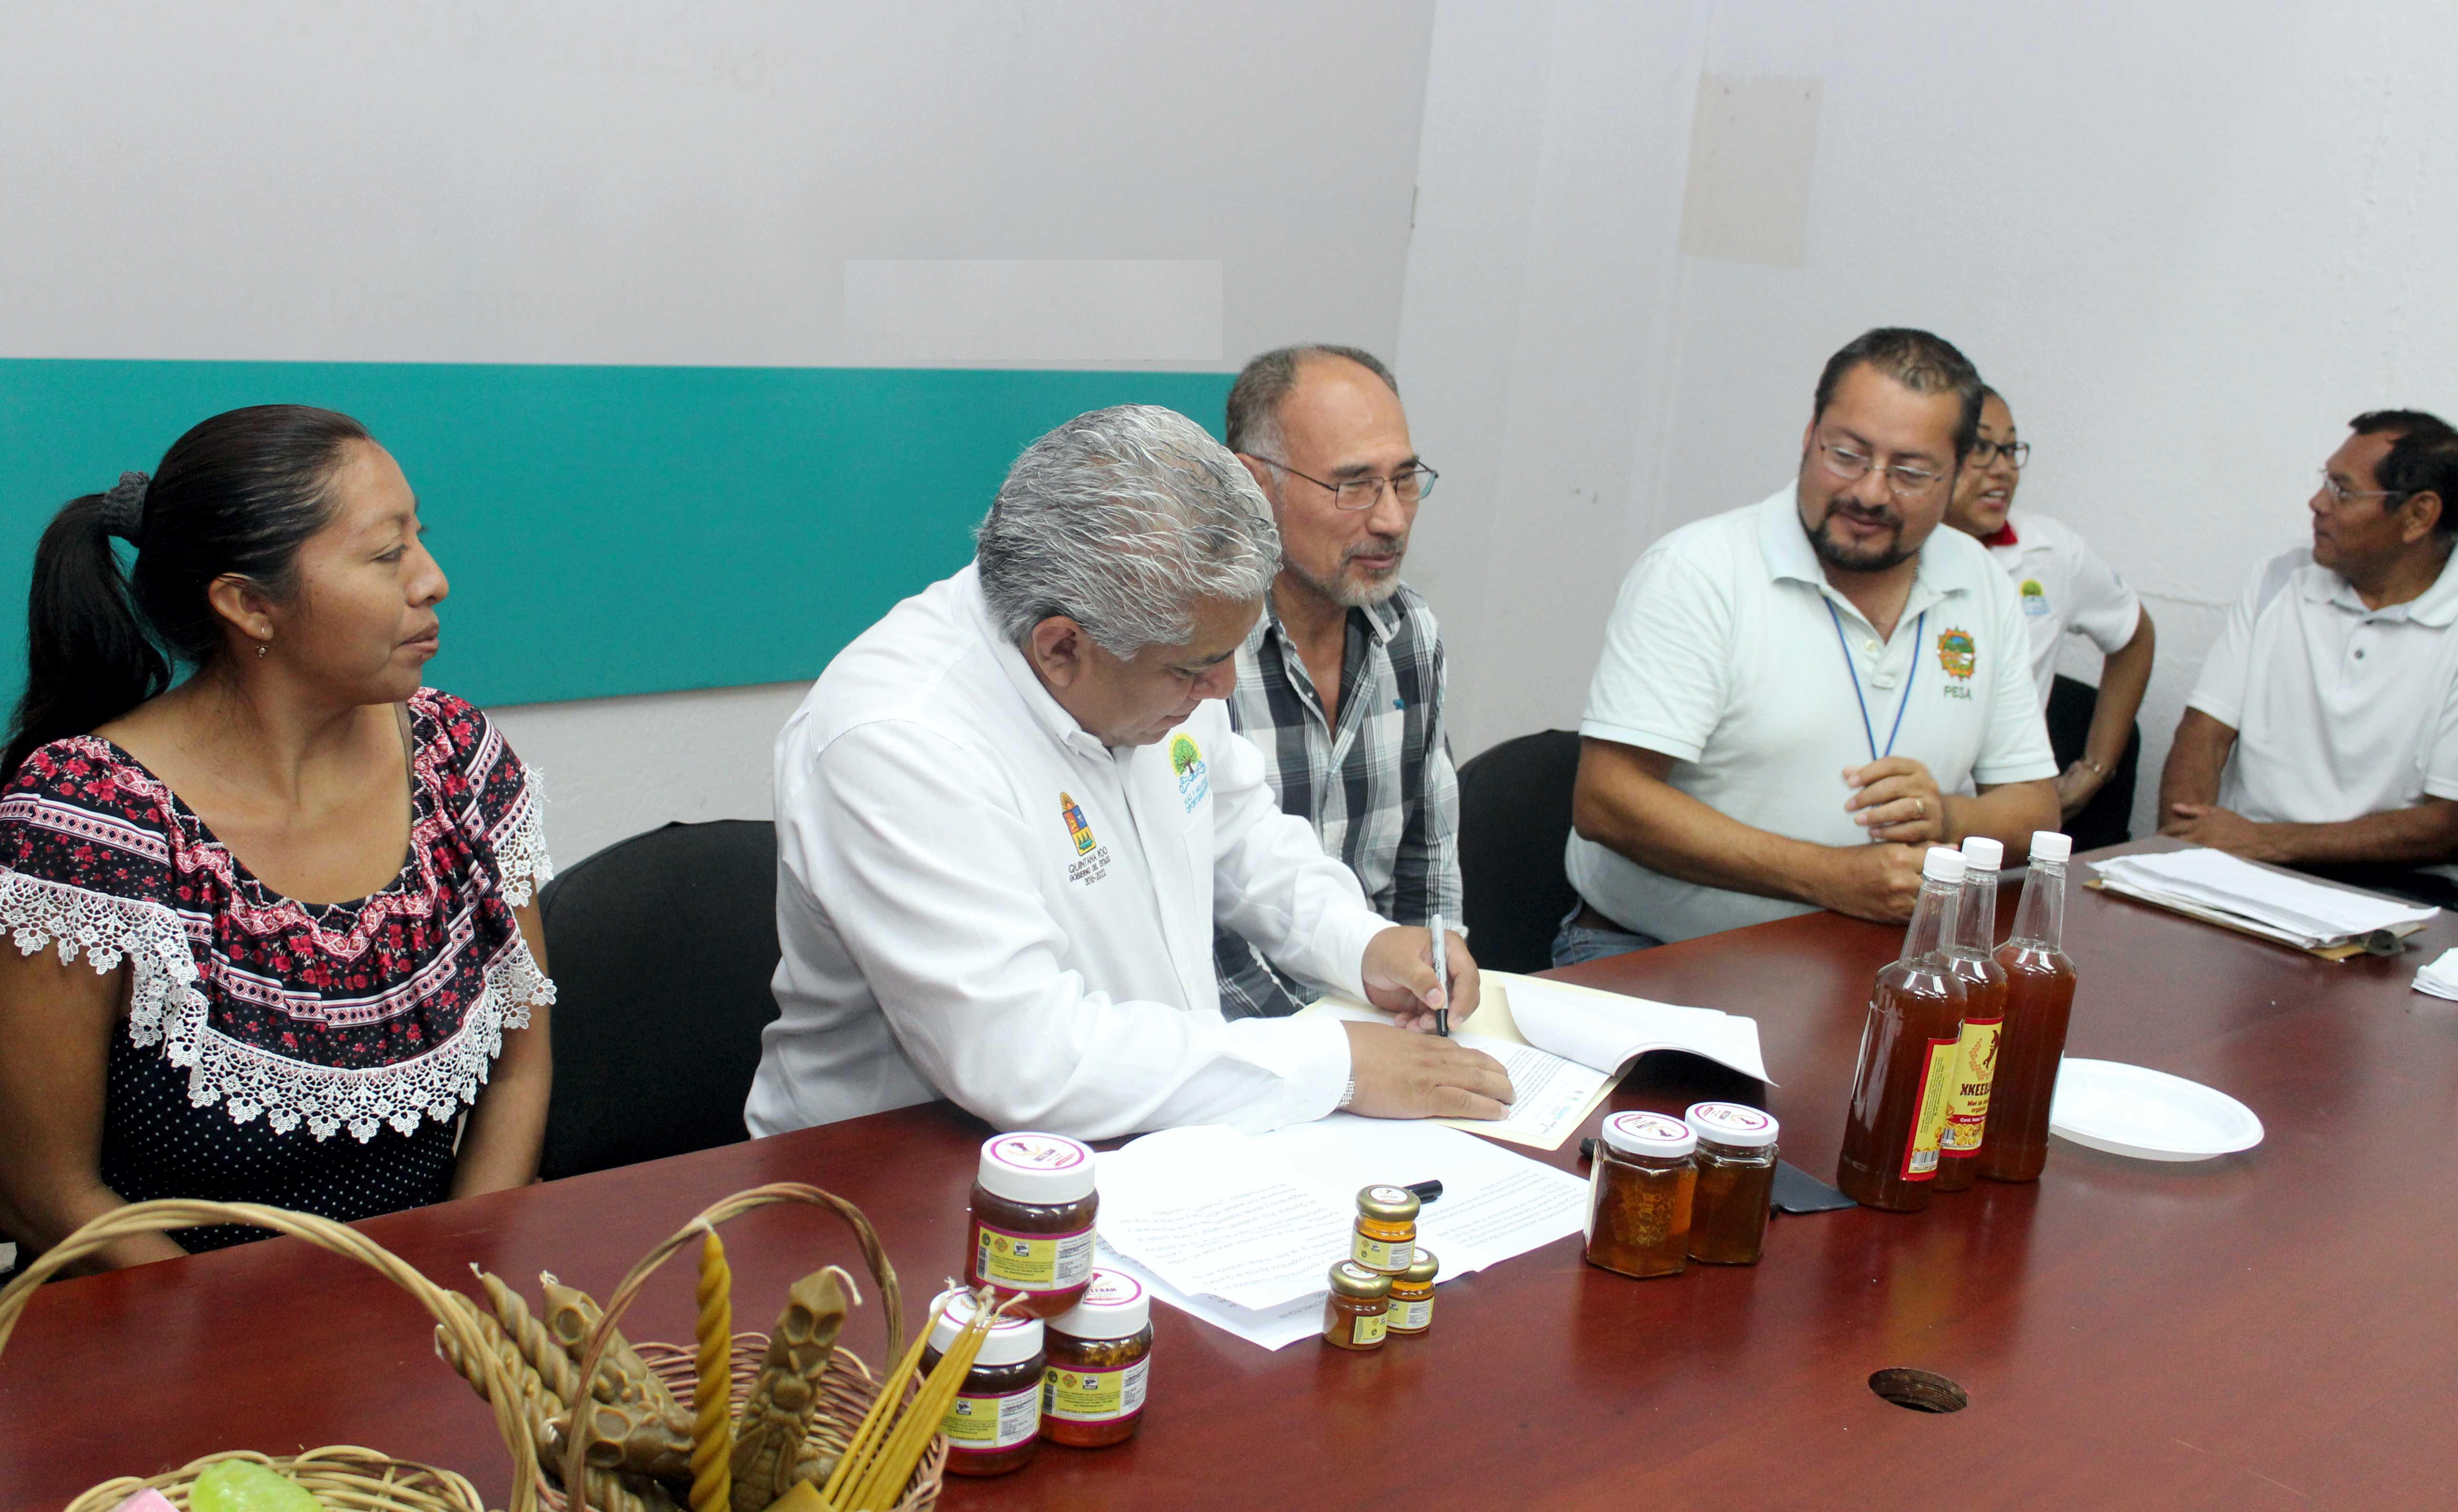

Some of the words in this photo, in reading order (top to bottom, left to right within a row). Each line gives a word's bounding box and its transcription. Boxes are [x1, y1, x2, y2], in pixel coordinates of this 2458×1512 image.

[1943, 685, 1972, 700] PESA
[1069, 853, 1097, 873] QUINTANA
[1097, 846, 1108, 857] ROO
[1069, 866, 1091, 882] GOBIERNO
[1099, 855, 1111, 867] ESTADO
